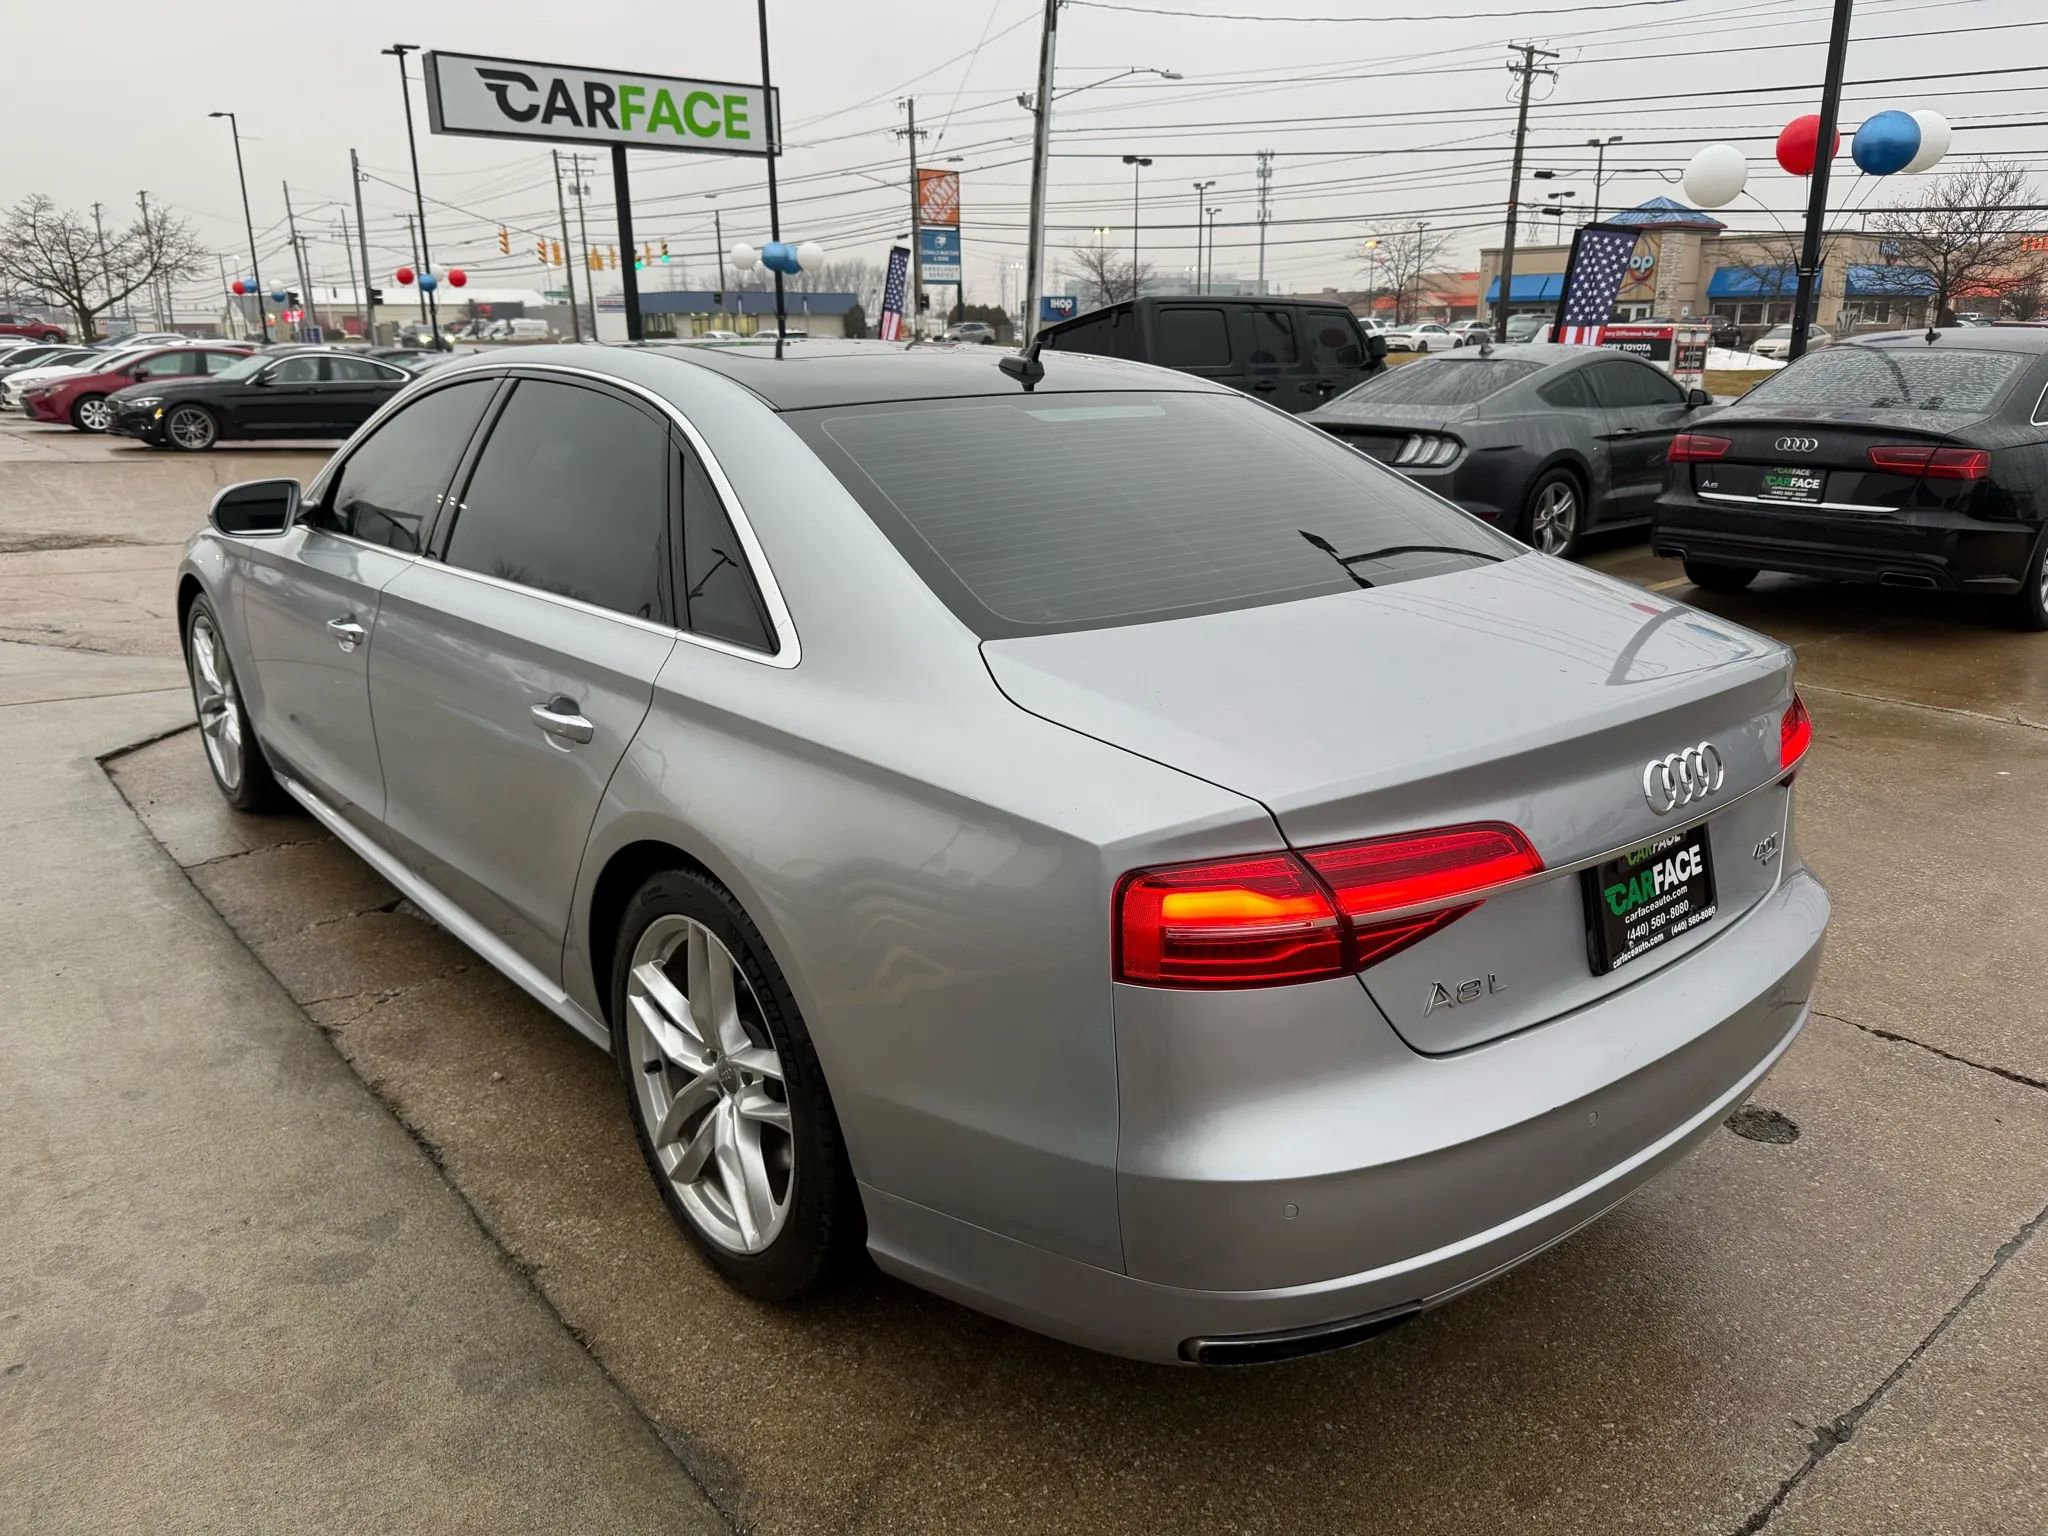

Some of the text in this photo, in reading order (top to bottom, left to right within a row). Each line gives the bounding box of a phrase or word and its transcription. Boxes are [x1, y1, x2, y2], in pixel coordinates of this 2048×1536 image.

[474, 67, 751, 140] CARFACE
[1622, 343, 1652, 351] TOYOTA
[1702, 480, 1719, 489] A6
[1765, 475, 1820, 489] CARFACE
[1604, 844, 1703, 916] CARFACE
[1625, 885, 1688, 924] carfaceauto.com
[1613, 932, 1664, 969] carfaceauto.com
[1671, 920, 1687, 937] (440)
[1627, 921, 1649, 941] (440)
